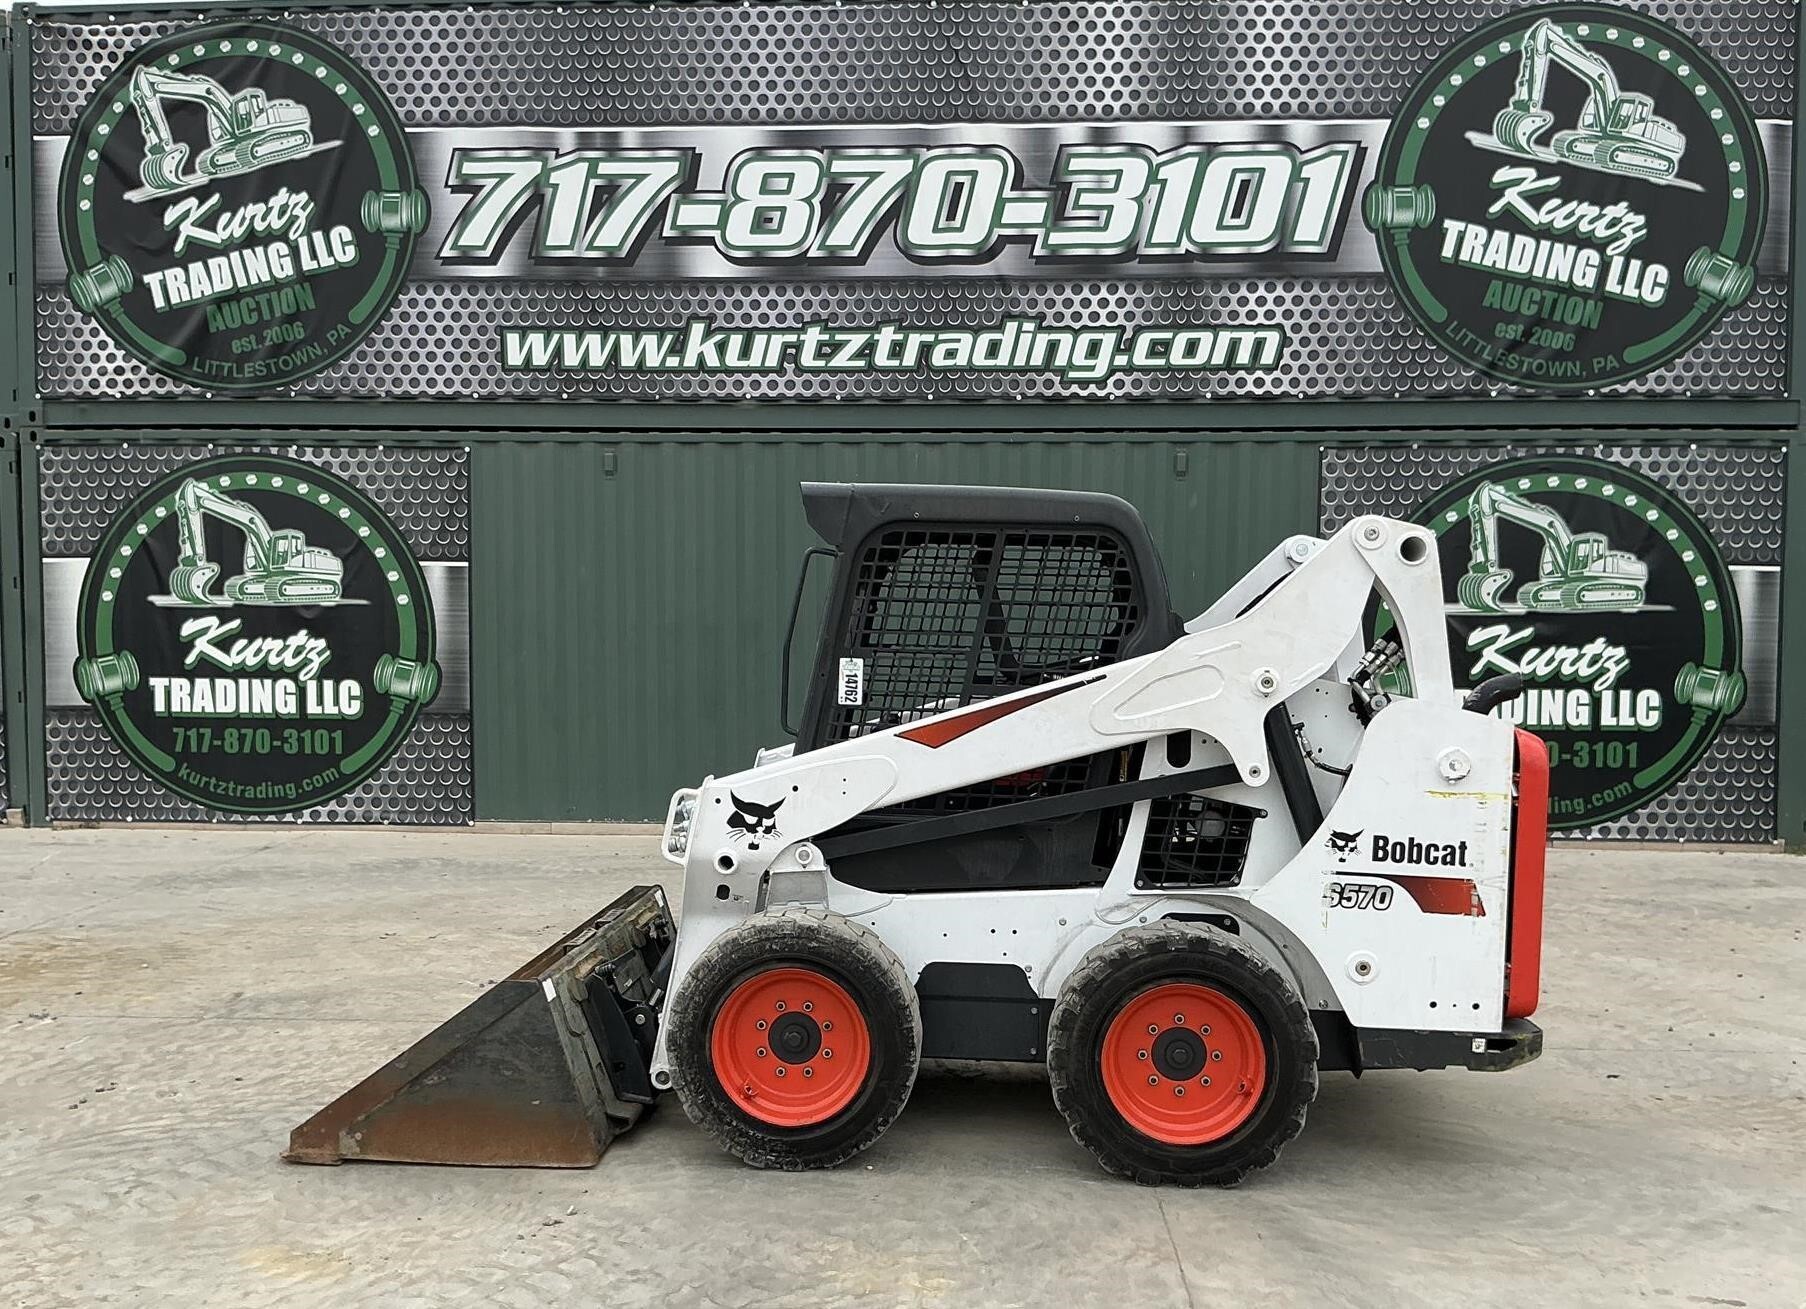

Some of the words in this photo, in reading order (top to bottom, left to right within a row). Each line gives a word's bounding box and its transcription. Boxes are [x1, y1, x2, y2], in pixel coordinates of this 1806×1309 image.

[163, 187, 315, 254] Kurtz
[441, 146, 1364, 263] 717-870-3101
[1489, 164, 1648, 256] Kurtz
[143, 241, 294, 312] TRADING
[298, 225, 358, 276] LLC
[1440, 219, 1600, 290] TRADING
[1605, 254, 1670, 304] LLC
[207, 283, 315, 332] AUCTION
[1482, 280, 1603, 329] AUCTION
[192, 343, 329, 378] LITTLESTOWN,
[327, 326, 352, 347] PA
[501, 319, 1285, 383] www.kurtztrading.com
[1445, 319, 1587, 377] LITTLESTOWN,
[1592, 355, 1619, 371] PA
[1494, 321, 1527, 343] est.
[1530, 328, 1575, 352] 2006
[180, 616, 330, 680] Kurtz
[1466, 624, 1631, 692] Kurtz
[149, 677, 297, 715] TRADING
[303, 678, 363, 716] LLC
[844, 672, 859, 703] 14762
[1600, 689, 1662, 727] LLC
[173, 728, 344, 754] 717-870-3101
[177, 763, 340, 799] kurtztrading.com
[1371, 835, 1468, 867] Bobcat
[1323, 882, 1394, 911] S570
